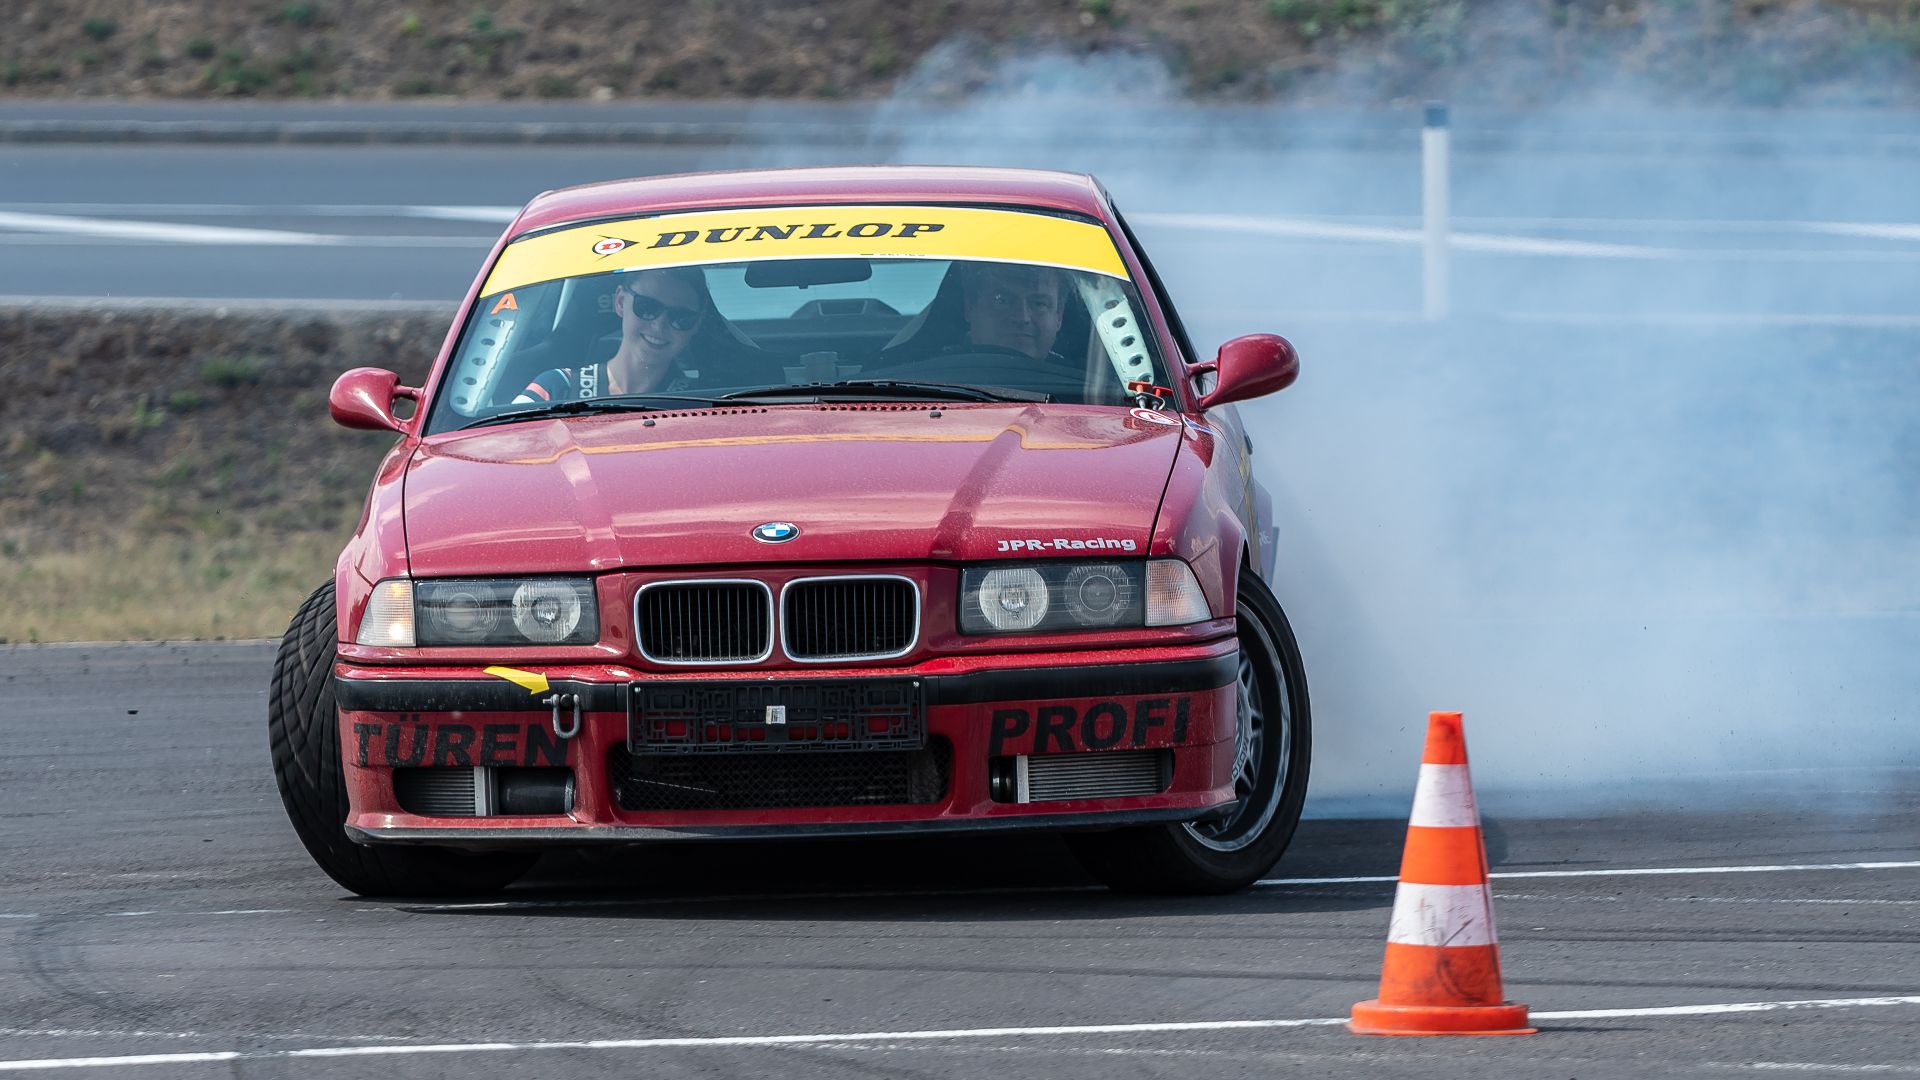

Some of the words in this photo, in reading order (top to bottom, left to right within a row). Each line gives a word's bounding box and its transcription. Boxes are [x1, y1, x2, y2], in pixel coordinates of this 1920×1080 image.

[646, 222, 945, 250] DUNLOP
[490, 292, 518, 315] A
[997, 537, 1137, 552] JPR-Racing
[353, 713, 571, 768] TÜREN
[988, 697, 1191, 756] PROFI
